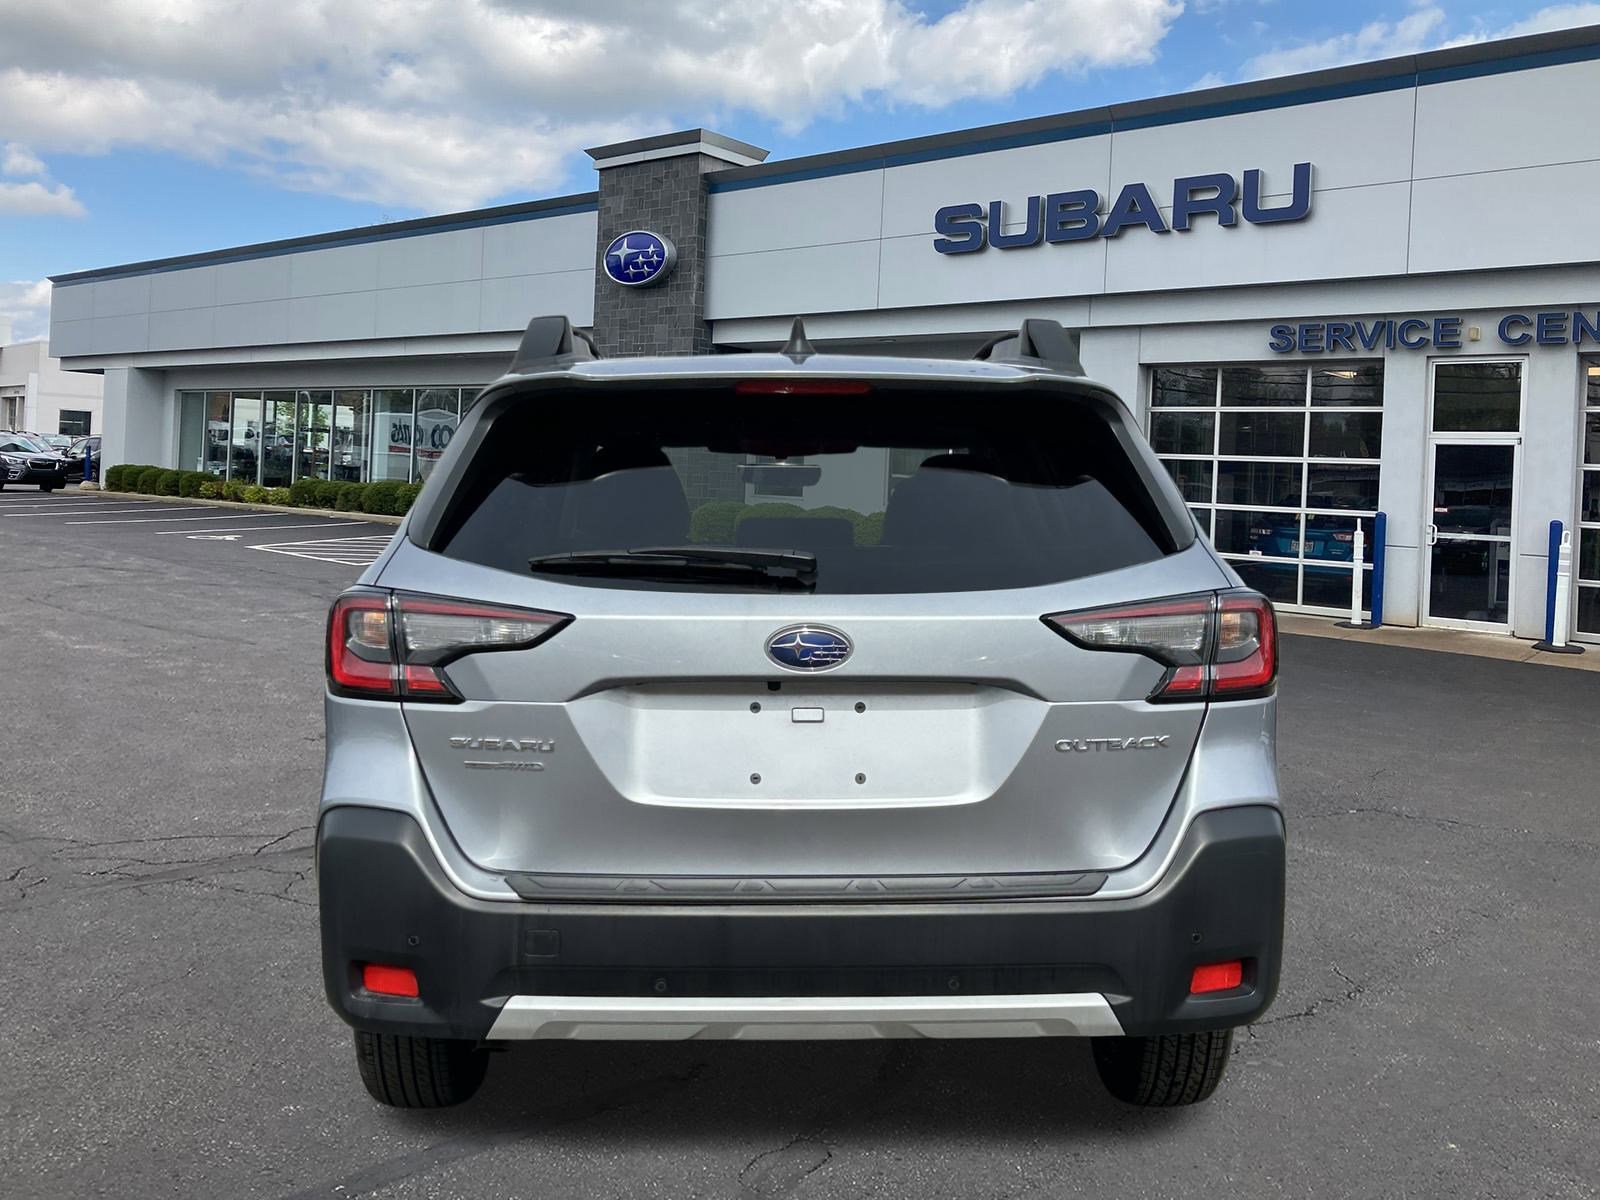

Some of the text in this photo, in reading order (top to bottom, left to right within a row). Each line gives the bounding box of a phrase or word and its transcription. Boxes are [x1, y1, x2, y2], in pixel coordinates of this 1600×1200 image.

[934, 162, 1313, 255] SUBARU
[1269, 311, 1600, 354] SERVICE CEN
[449, 736, 556, 753] SUBARU
[1054, 734, 1170, 753] OUTBACK
